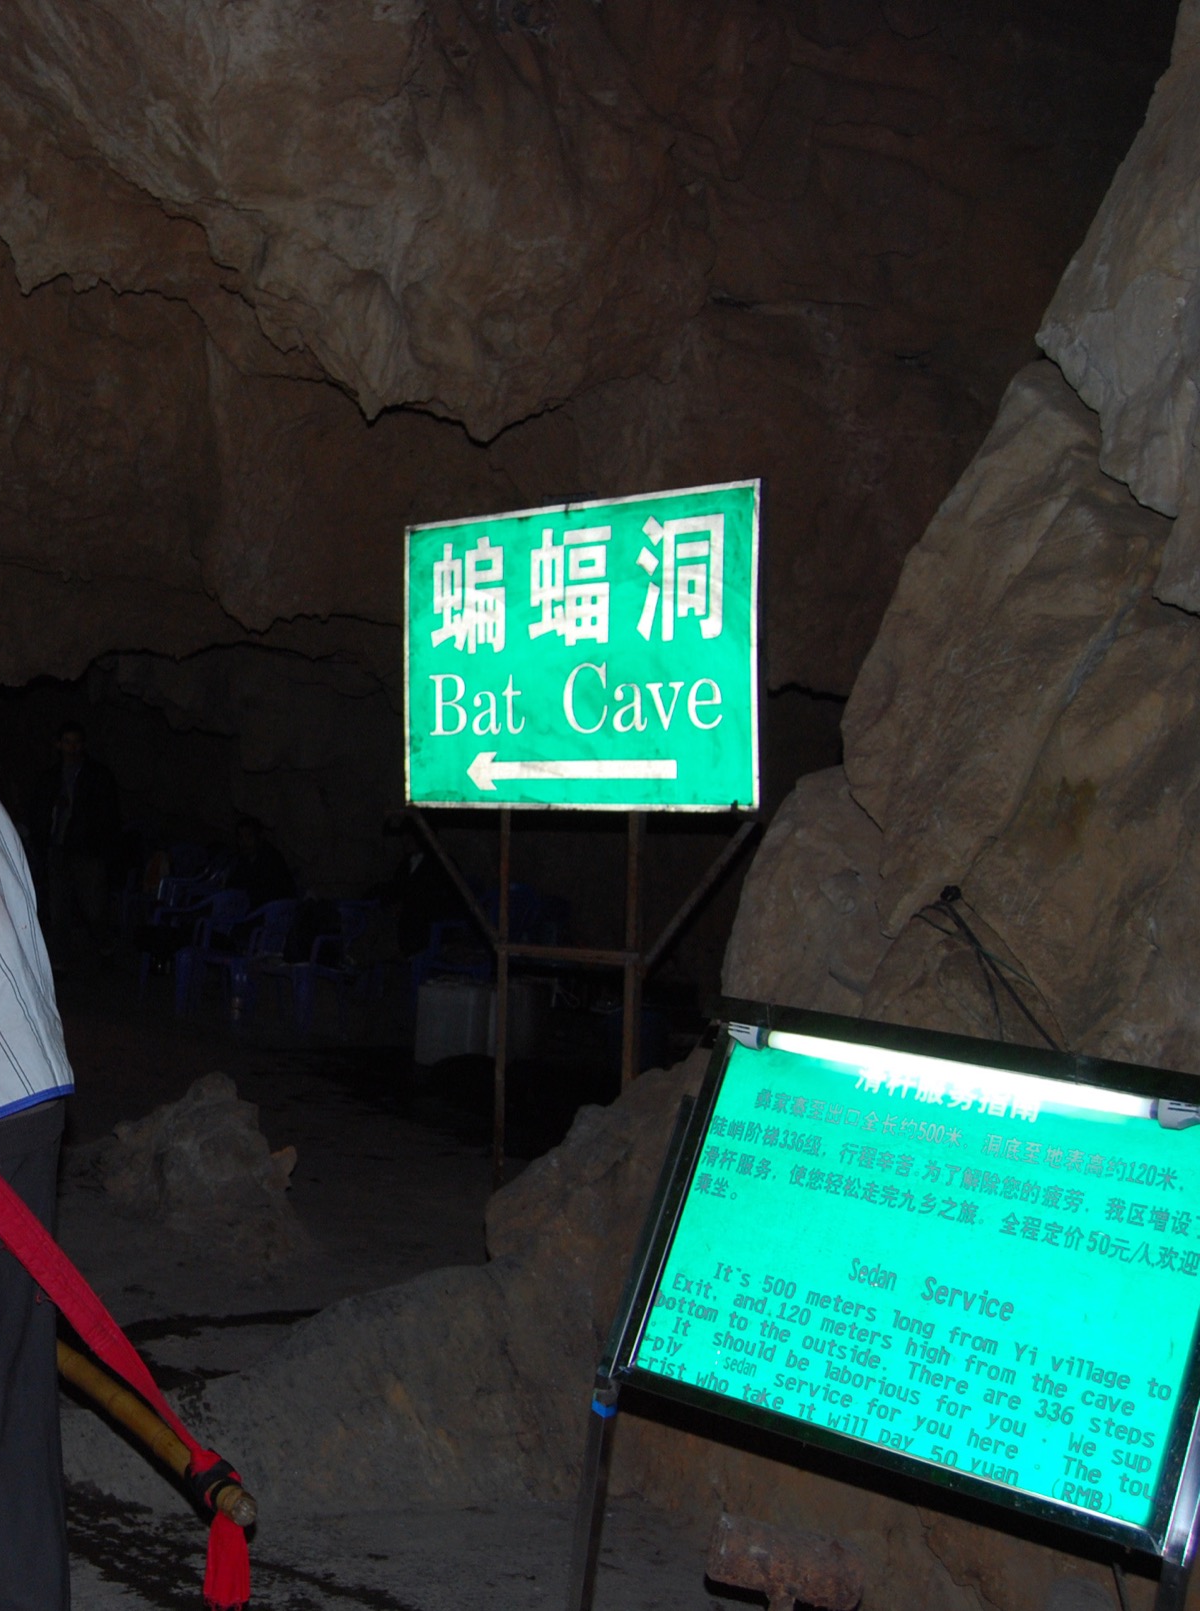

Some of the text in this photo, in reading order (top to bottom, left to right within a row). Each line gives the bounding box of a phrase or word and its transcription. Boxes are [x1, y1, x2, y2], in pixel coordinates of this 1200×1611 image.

[431, 513, 725, 654] 蝙蝠洞
[429, 661, 723, 737] Bat Cave
[761, 1274, 797, 1299] 500
[805, 1290, 877, 1322] meters
[892, 1309, 935, 1339] long
[949, 1326, 999, 1355] from
[1014, 1341, 1038, 1366] Yi
[1051, 1355, 1131, 1390] village
[1147, 1377, 1172, 1401] to
[848, 1257, 1014, 1321] Sedan Service
[654, 1290, 1155, 1448] bottom to the outside. There are 336 steps
[672, 1317, 1152, 1474] It should be laborious for you We sup
[733, 1293, 768, 1314] and
[776, 1302, 811, 1326] 120
[820, 1317, 893, 1350] meters
[905, 1337, 951, 1366] high
[965, 1354, 1016, 1385] from
[1031, 1373, 1068, 1398] the
[1081, 1390, 1135, 1416] cave
[695, 1371, 729, 1394] who
[742, 1383, 784, 1410] take
[798, 1403, 816, 1421] it
[827, 1412, 868, 1437] will
[878, 1428, 915, 1451] pay
[929, 1444, 959, 1468] 50
[970, 1457, 1019, 1487] yuan
[723, 1356, 757, 1378] sedan
[773, 1372, 853, 1408] service
[867, 1398, 902, 1422] for
[912, 1415, 953, 1439] you
[966, 1428, 1019, 1459] here
[1063, 1455, 1102, 1484] The
